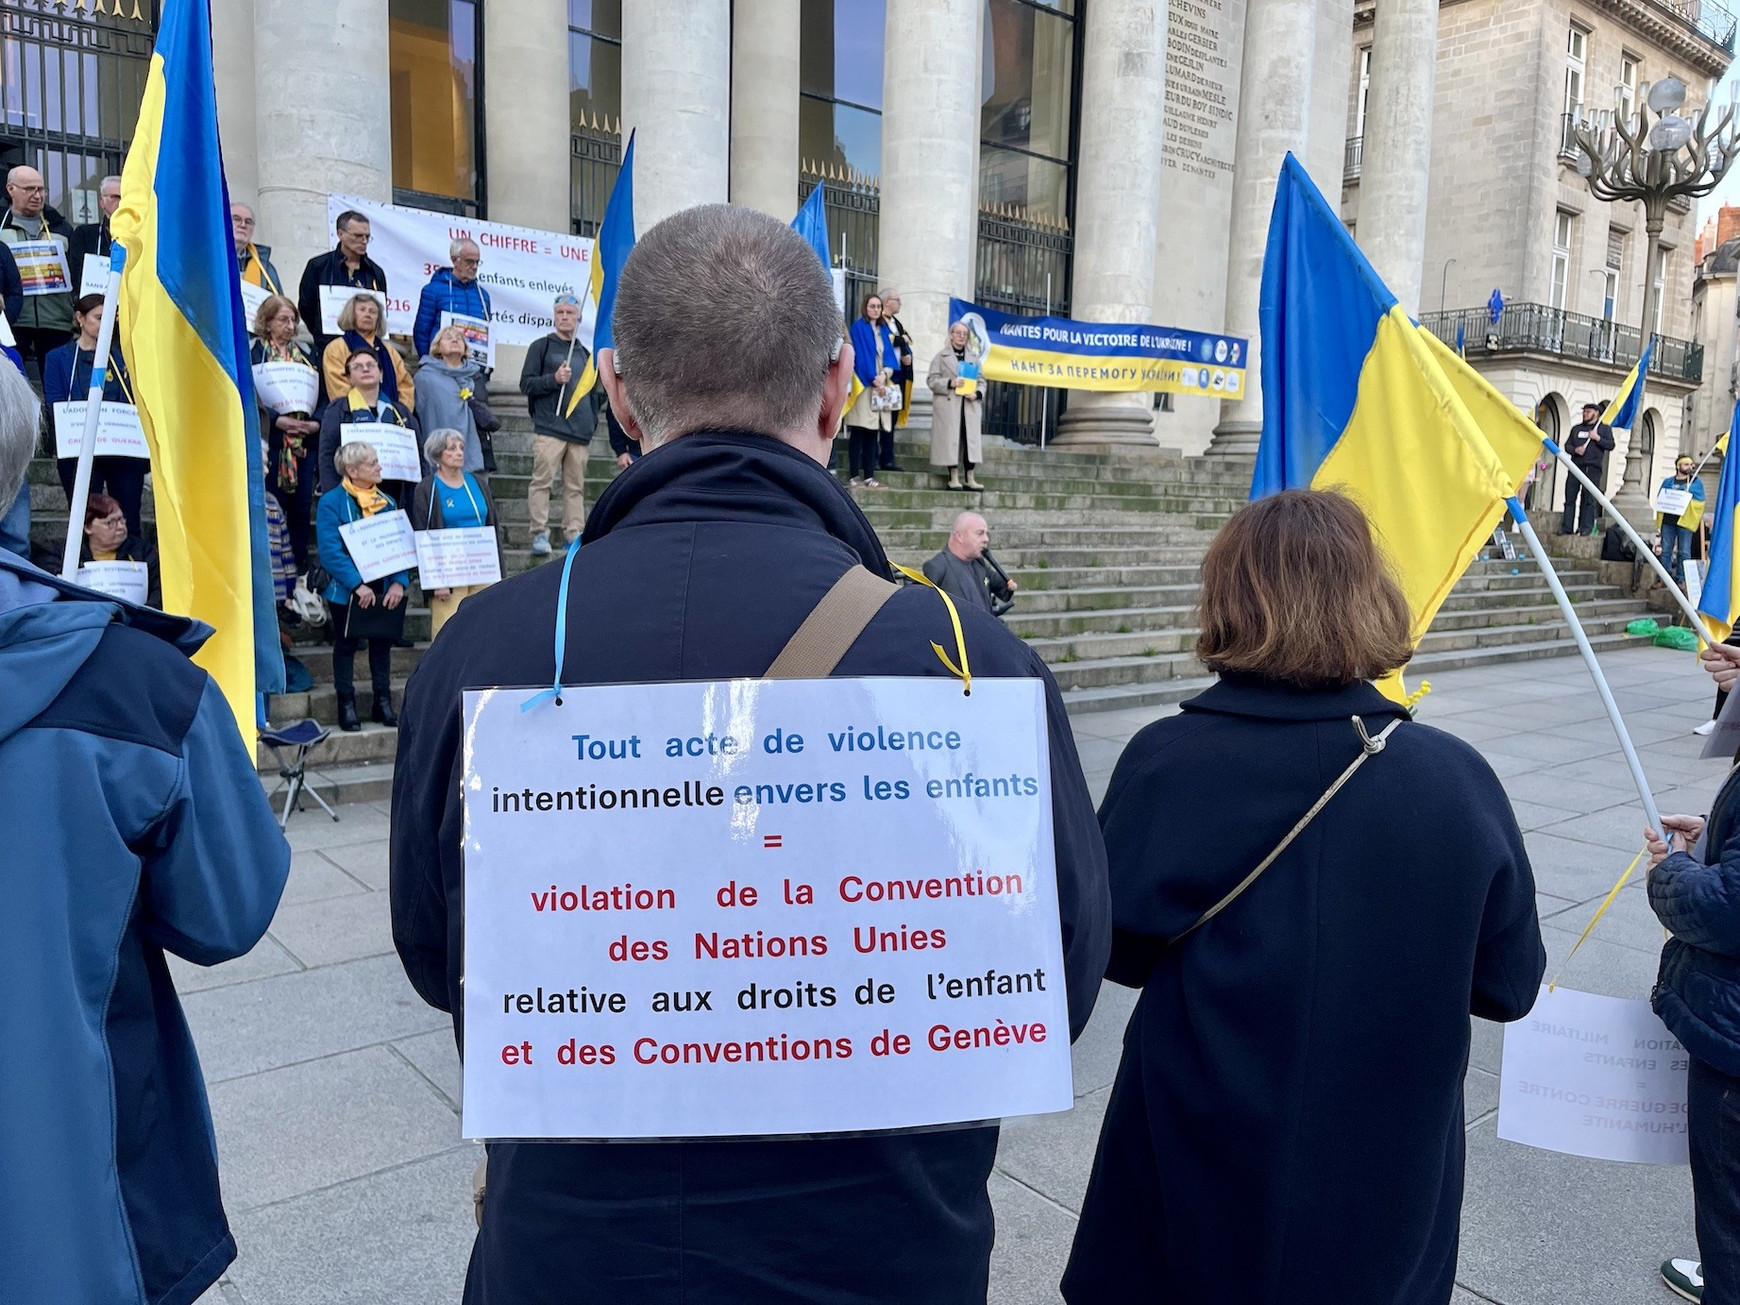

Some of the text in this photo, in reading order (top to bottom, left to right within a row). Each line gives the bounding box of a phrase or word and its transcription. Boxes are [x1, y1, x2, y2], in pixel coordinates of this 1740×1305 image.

[449, 227, 471, 240] UN
[480, 232, 537, 254] CHIFFRE
[560, 245, 589, 262] UNE
[528, 281, 574, 295] enlevés
[518, 312, 556, 329] dispa
[1000, 323, 1041, 339] NANTES
[1043, 327, 1069, 343] POUR
[1070, 331, 1082, 345] LA
[1083, 333, 1138, 347] VICTOIRE
[1140, 334, 1150, 348] DE
[1011, 359, 1044, 374] НАНТ
[1048, 364, 1063, 375] ЗА
[1067, 365, 1137, 380] ПЕРЕМОГУ
[572, 726, 961, 760] Tout acte de violence
[493, 773, 1038, 812] intentionnelle envers les enfants
[531, 870, 1022, 912] violation de la Convention
[609, 924, 946, 962] des Nations Unies
[503, 968, 1046, 1014] relative aux droits de l’enfant
[502, 1019, 1047, 1065] et des Conventions de Genève
